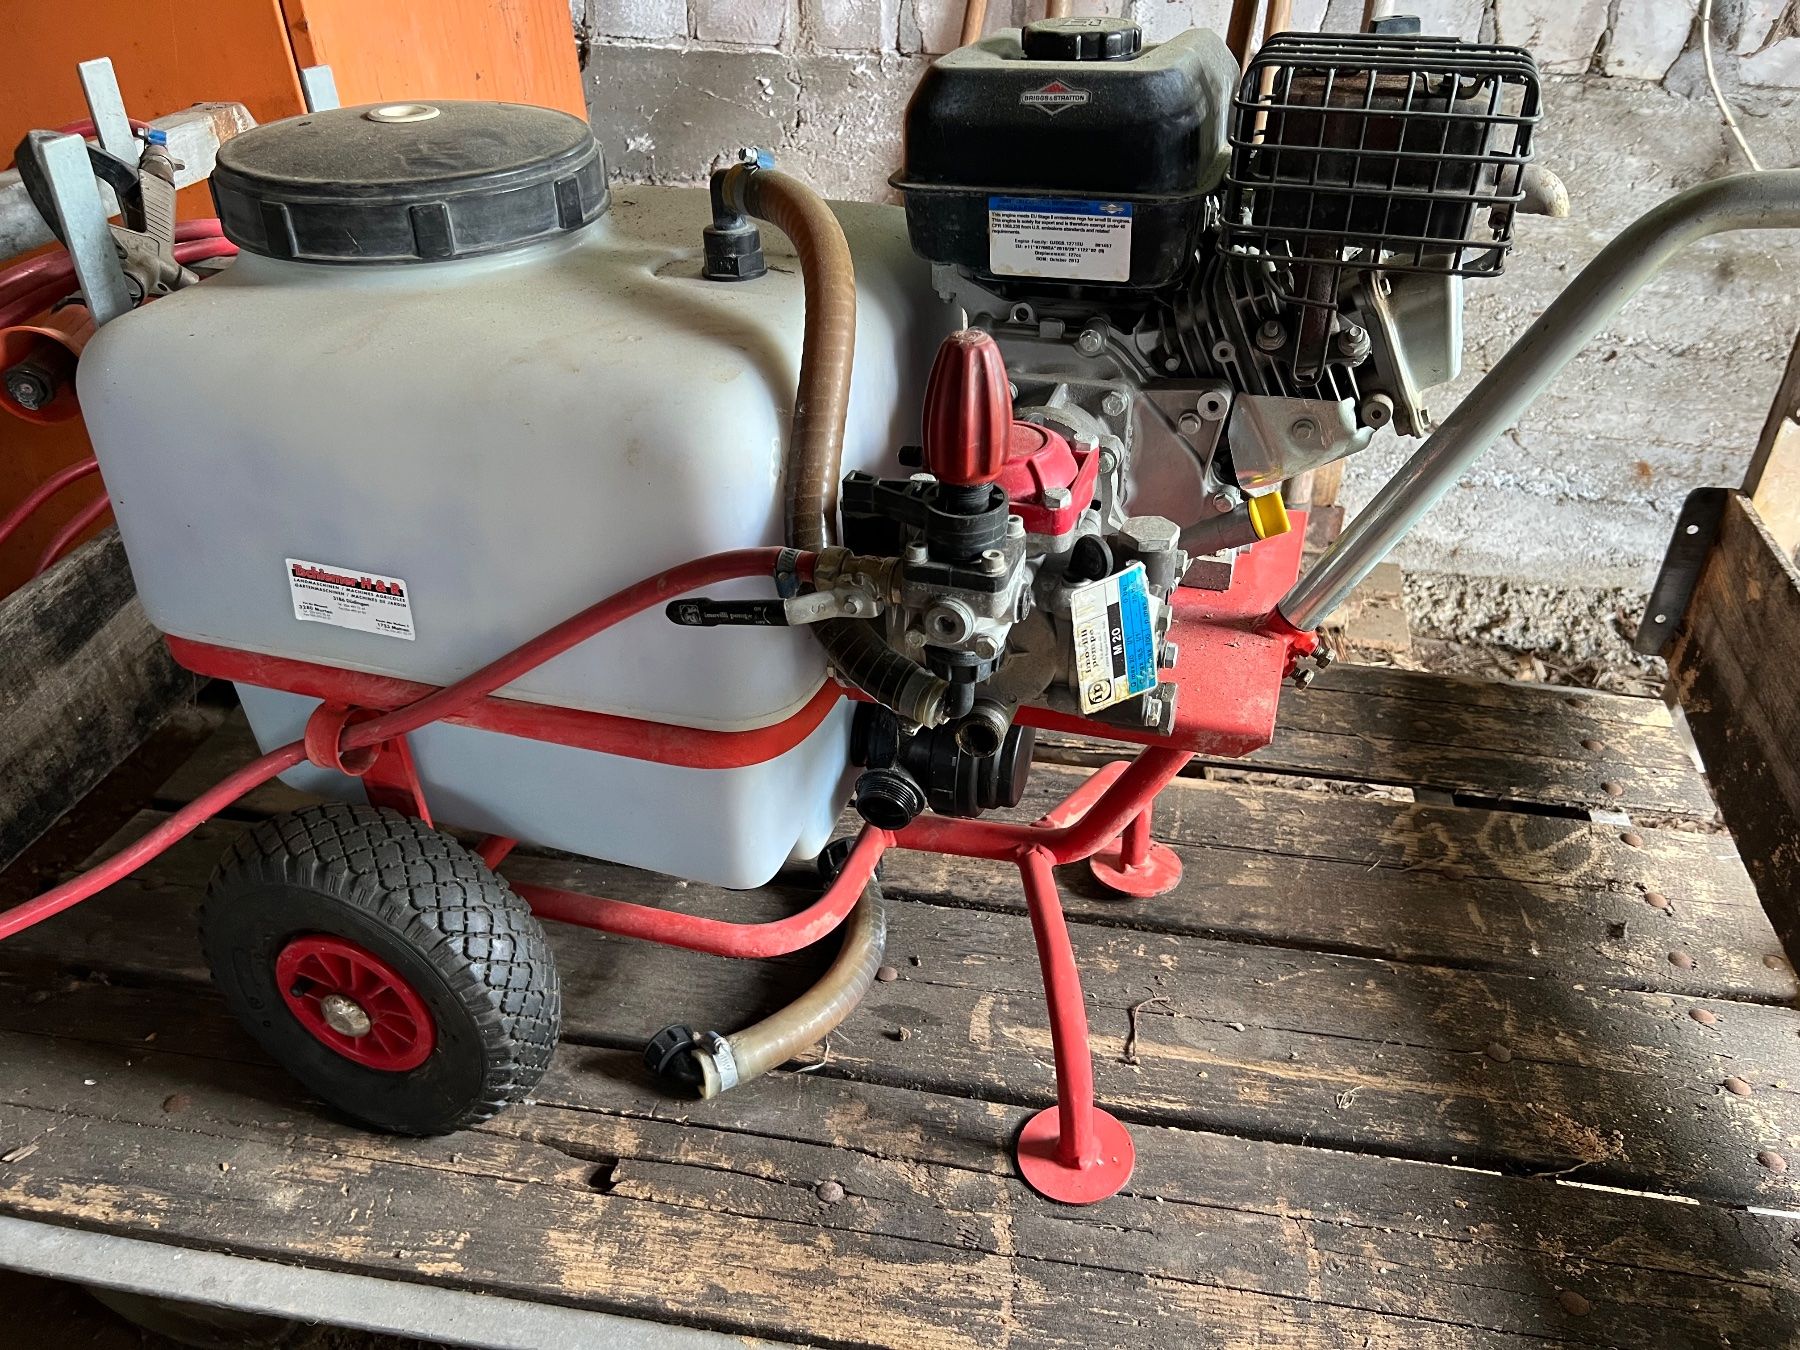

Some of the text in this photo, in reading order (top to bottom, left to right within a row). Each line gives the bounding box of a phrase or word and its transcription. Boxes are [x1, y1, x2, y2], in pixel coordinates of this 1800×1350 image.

[293, 577, 339, 589] LANDMASCHINEN
[345, 587, 373, 596] MACHINES
[375, 593, 405, 602] AGRICOLES
[294, 583, 344, 595] GARTENMASCHINEN
[350, 593, 377, 602] MACHINES
[360, 577, 372, 589] H
[375, 580, 387, 593] &
[390, 582, 401, 595] R
[1088, 627, 1098, 668] pompe
[1111, 626, 1122, 655] M 20
